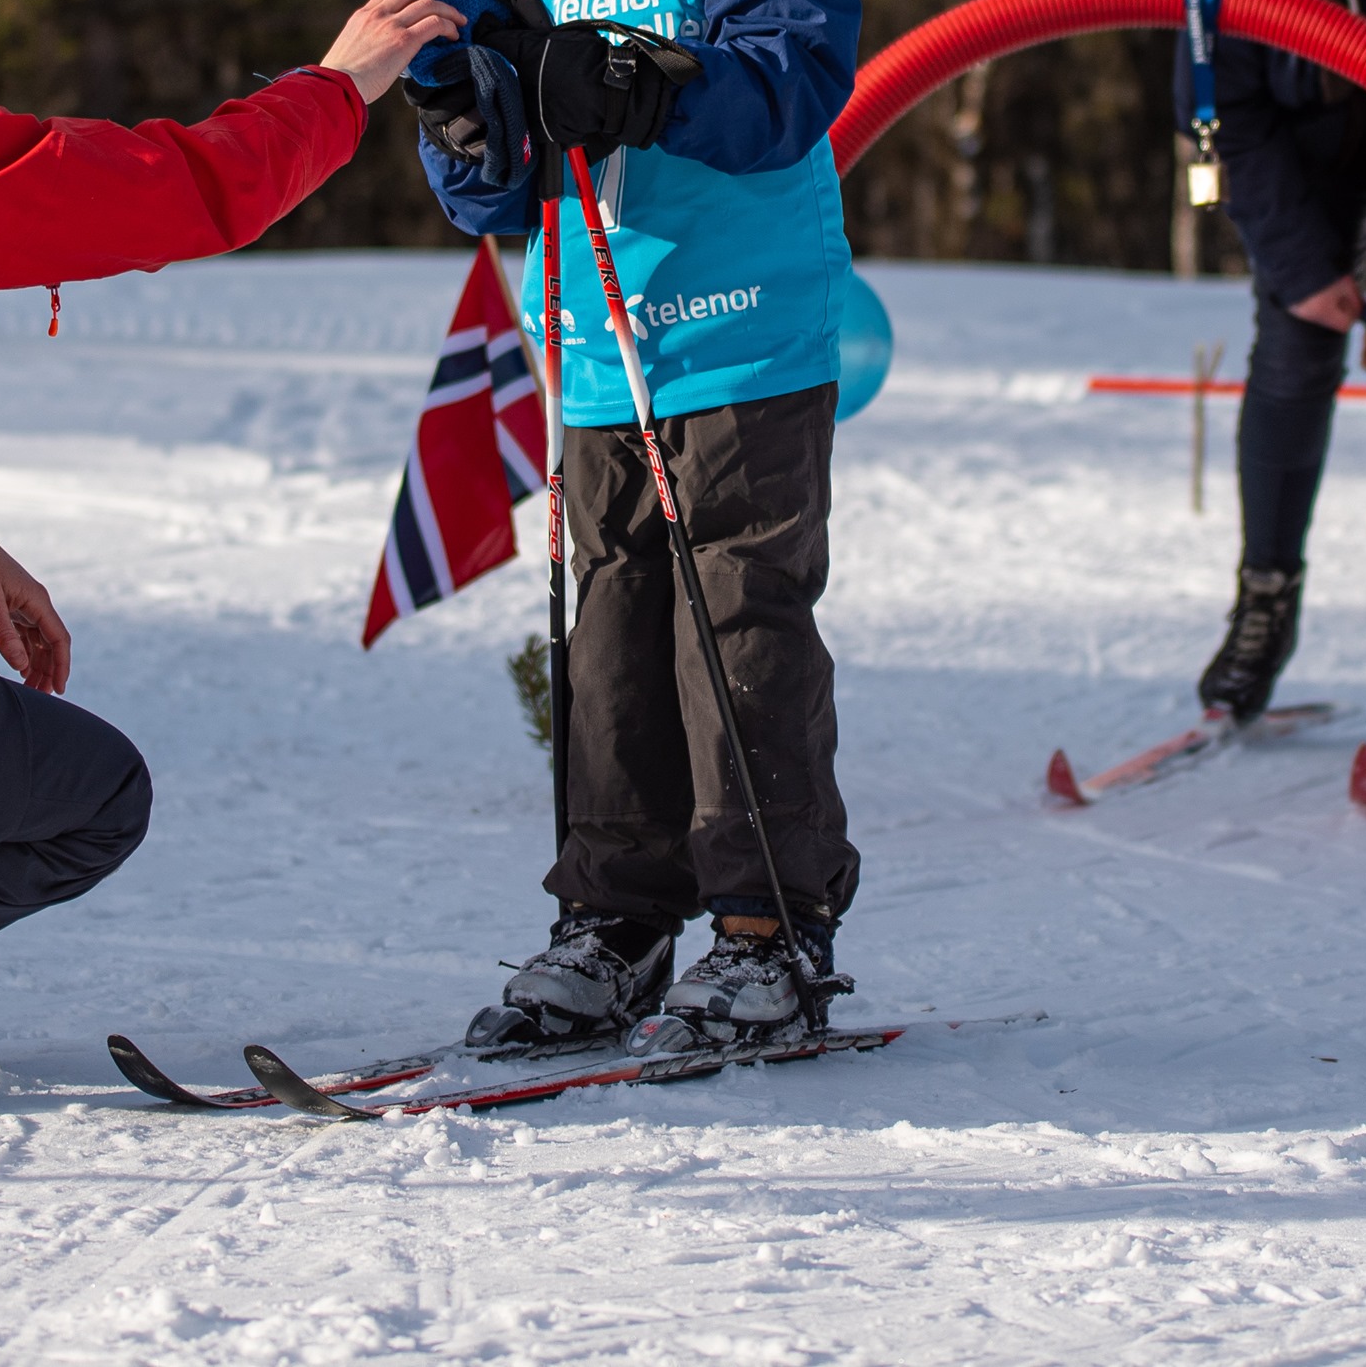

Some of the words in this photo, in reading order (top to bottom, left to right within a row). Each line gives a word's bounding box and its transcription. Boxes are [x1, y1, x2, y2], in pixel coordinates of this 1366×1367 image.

[588, 227, 621, 300] LEKI
[548, 275, 562, 347] LEKI
[645, 285, 761, 327] telenor
[639, 1034, 885, 1078] MADSHUS
